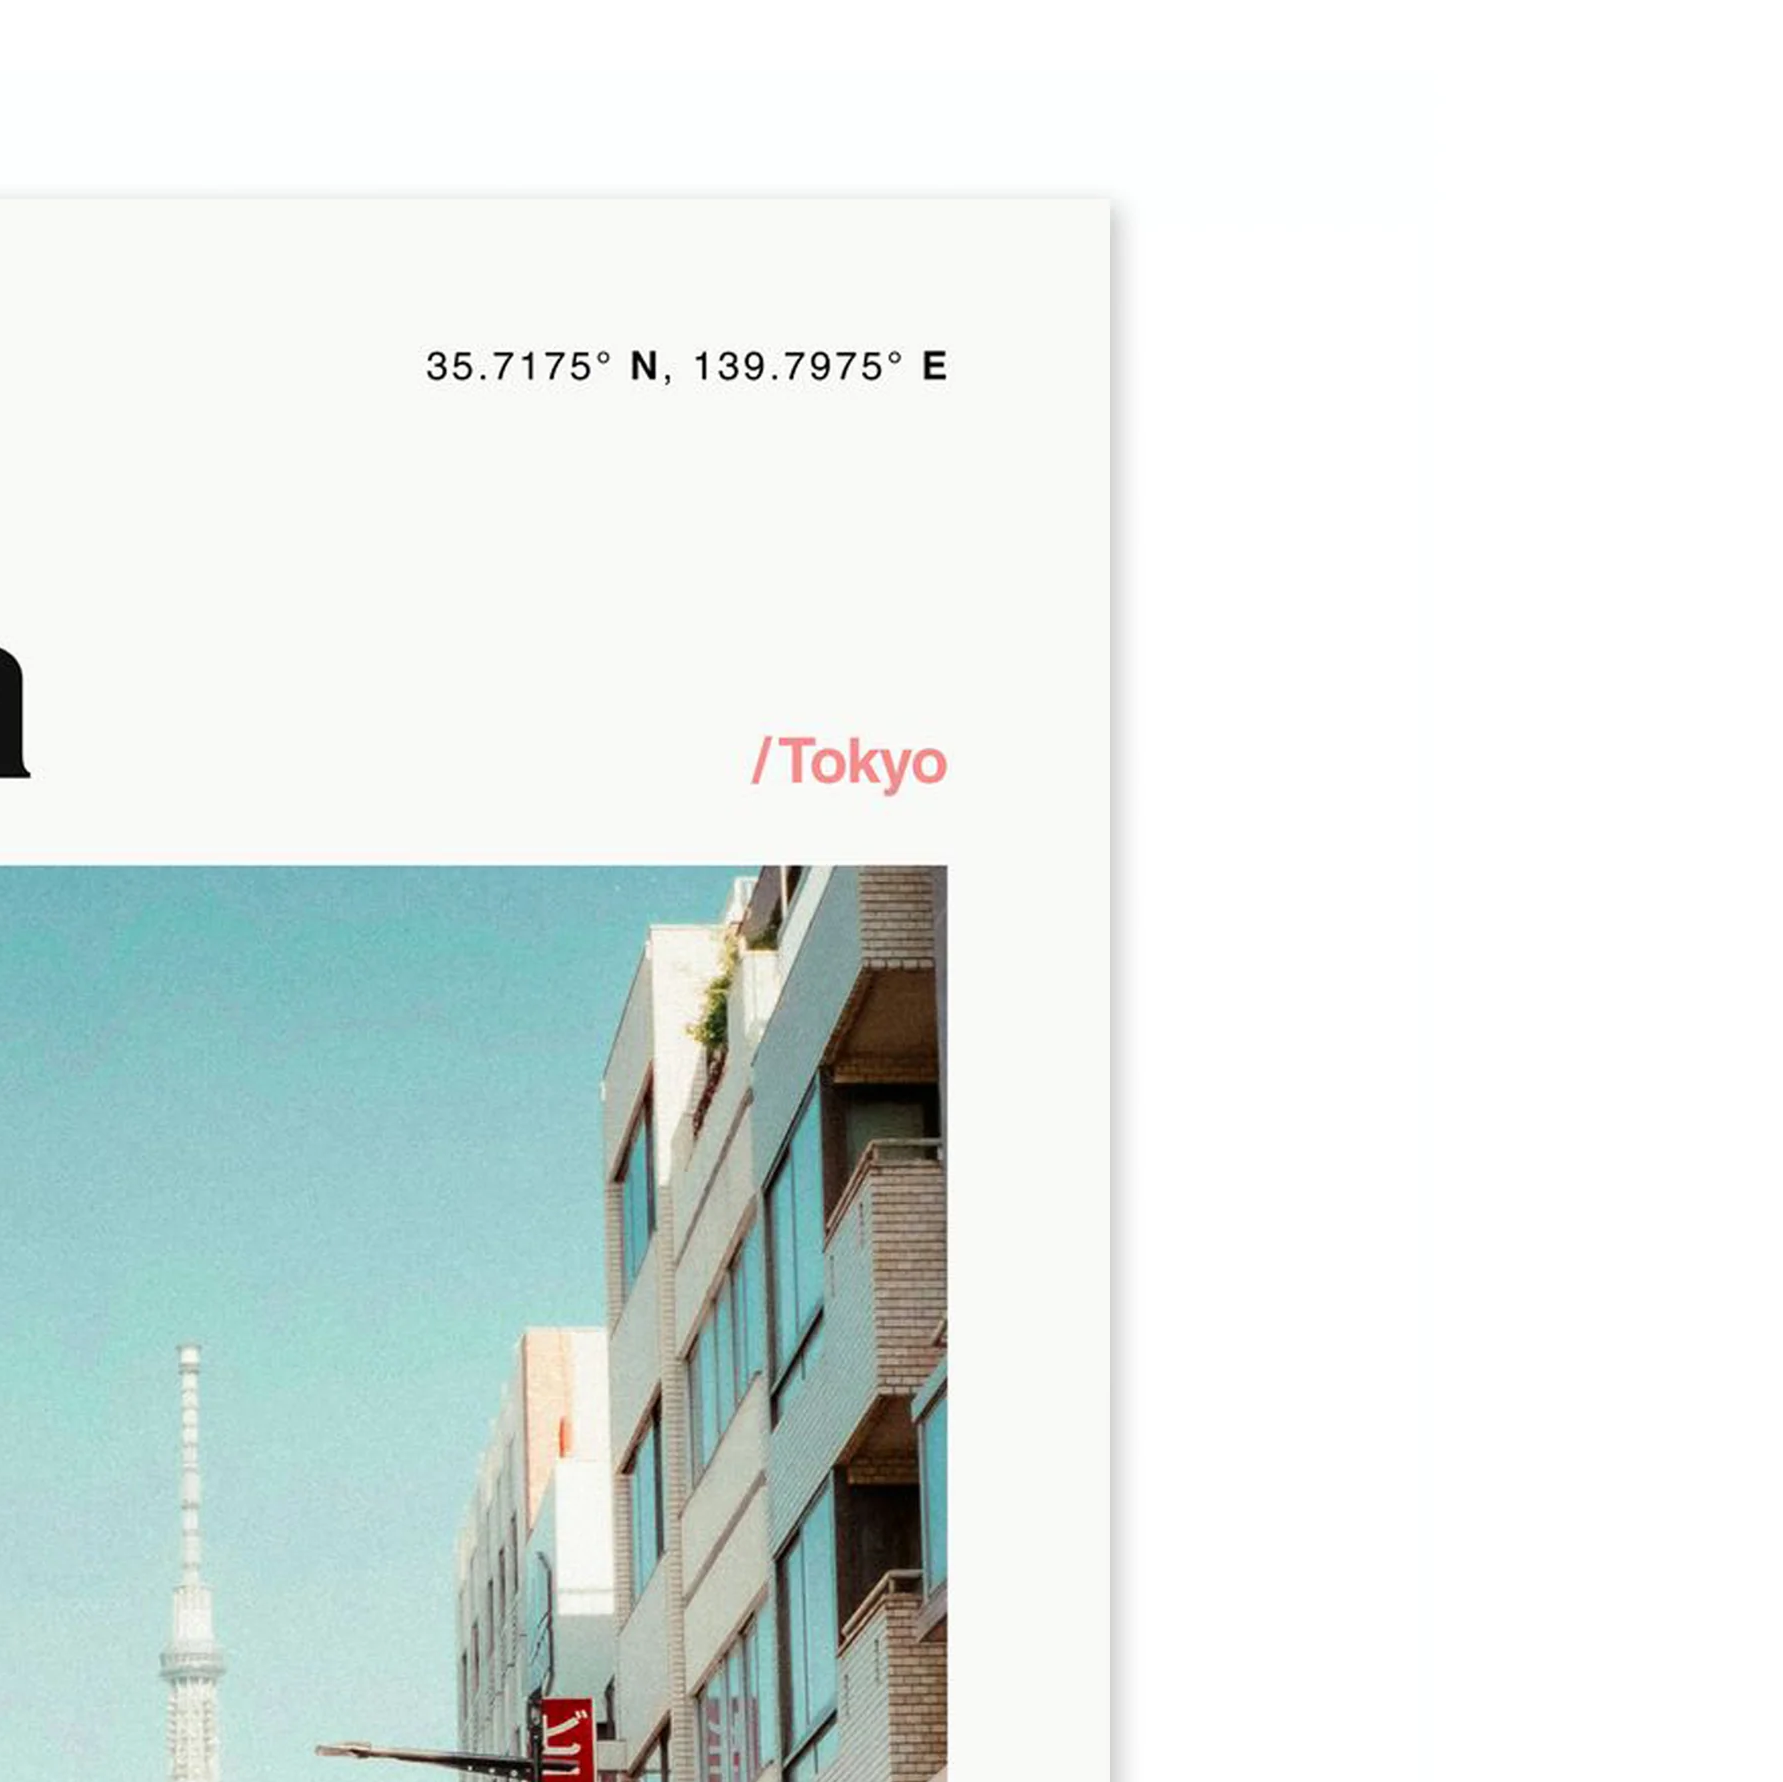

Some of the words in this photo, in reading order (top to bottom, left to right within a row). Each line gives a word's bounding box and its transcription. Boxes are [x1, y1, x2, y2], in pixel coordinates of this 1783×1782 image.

[426, 350, 611, 382] 35.7175°
[631, 349, 671, 386] N,
[694, 350, 902, 382] 139.7975°
[922, 349, 947, 381] E
